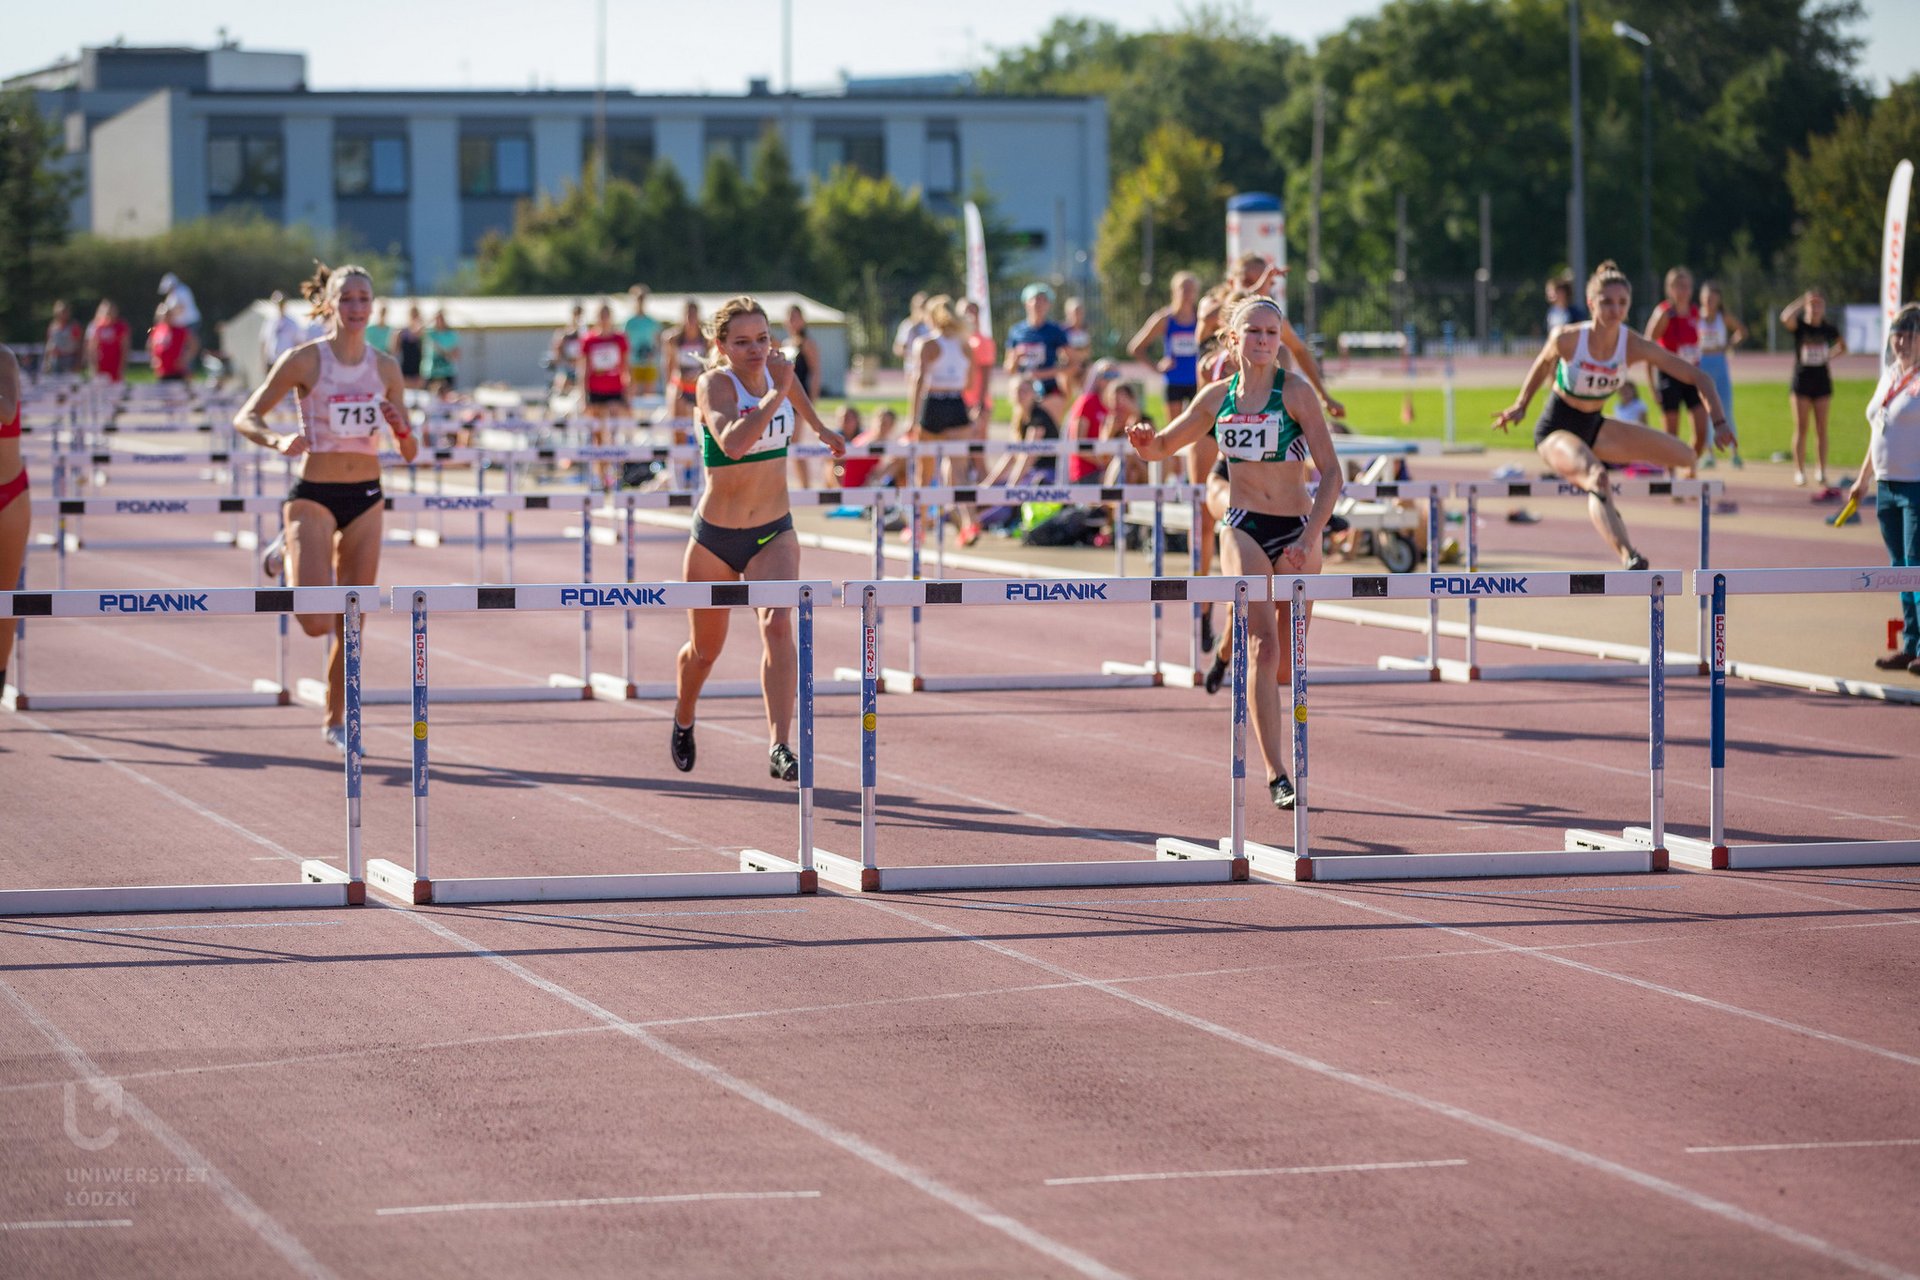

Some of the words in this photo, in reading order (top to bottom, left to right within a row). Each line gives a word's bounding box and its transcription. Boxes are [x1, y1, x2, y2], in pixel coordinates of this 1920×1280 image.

[338, 407, 376, 425] 713
[1224, 428, 1266, 448] 821
[424, 497, 494, 509] POLANIK
[1006, 489, 1070, 501] POLANIK
[116, 500, 188, 514] POLANIK
[1006, 582, 1107, 600] POLANIK
[1430, 577, 1528, 594] POLANIK
[99, 593, 208, 612] POLANIK
[561, 588, 666, 606] POLANIK
[1715, 615, 1725, 667] POLANIK
[416, 634, 425, 681] POLANIK
[866, 627, 875, 674] POLANIK
